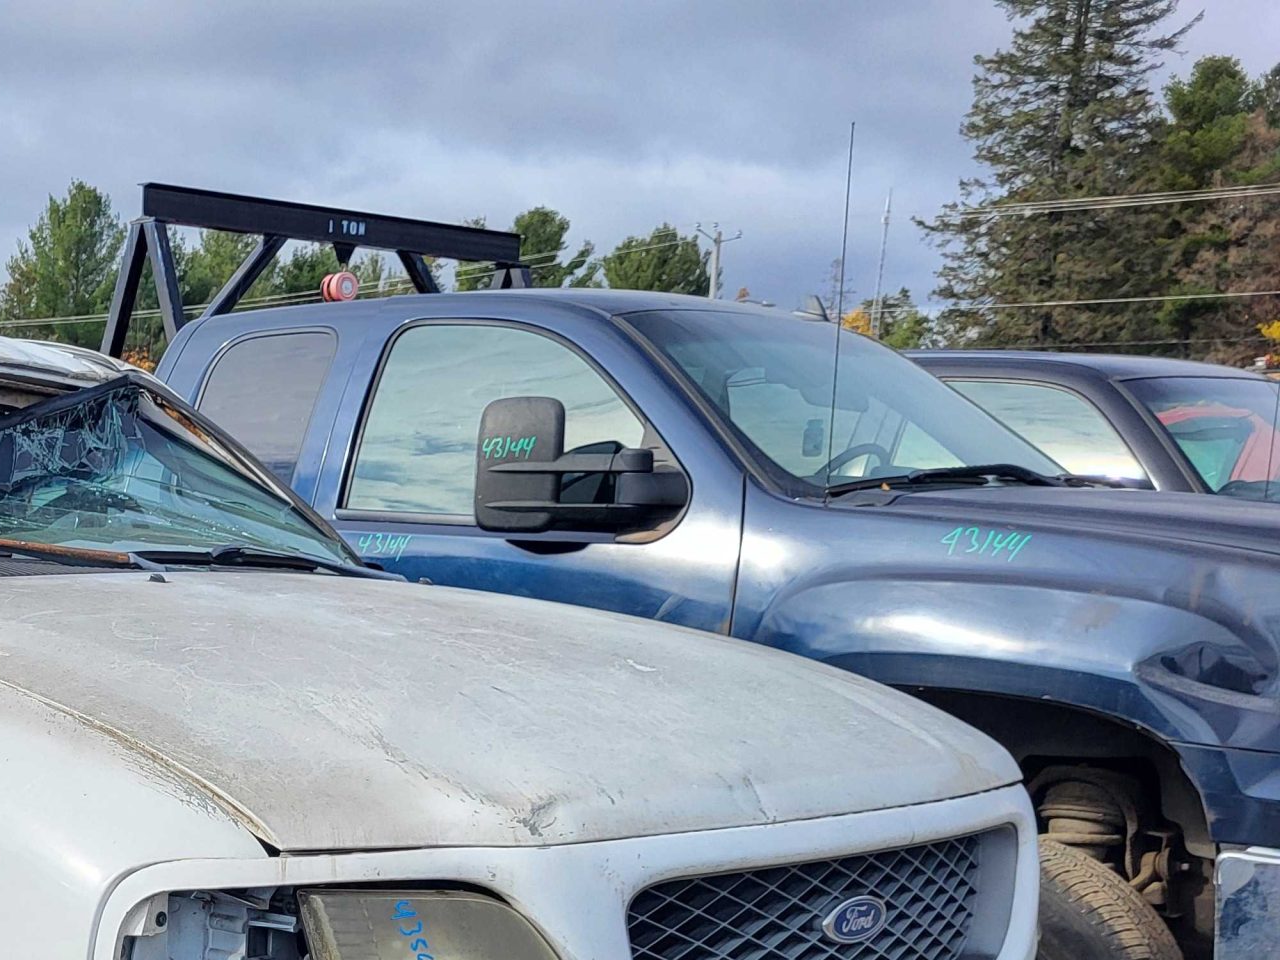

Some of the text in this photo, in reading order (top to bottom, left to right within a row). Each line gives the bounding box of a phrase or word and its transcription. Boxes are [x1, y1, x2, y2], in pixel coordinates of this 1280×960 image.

[341, 219, 367, 237] TON
[482, 435, 537, 460] 43144
[358, 533, 413, 562] 43144
[939, 526, 1033, 562] 43144
[840, 904, 877, 933] Ford
